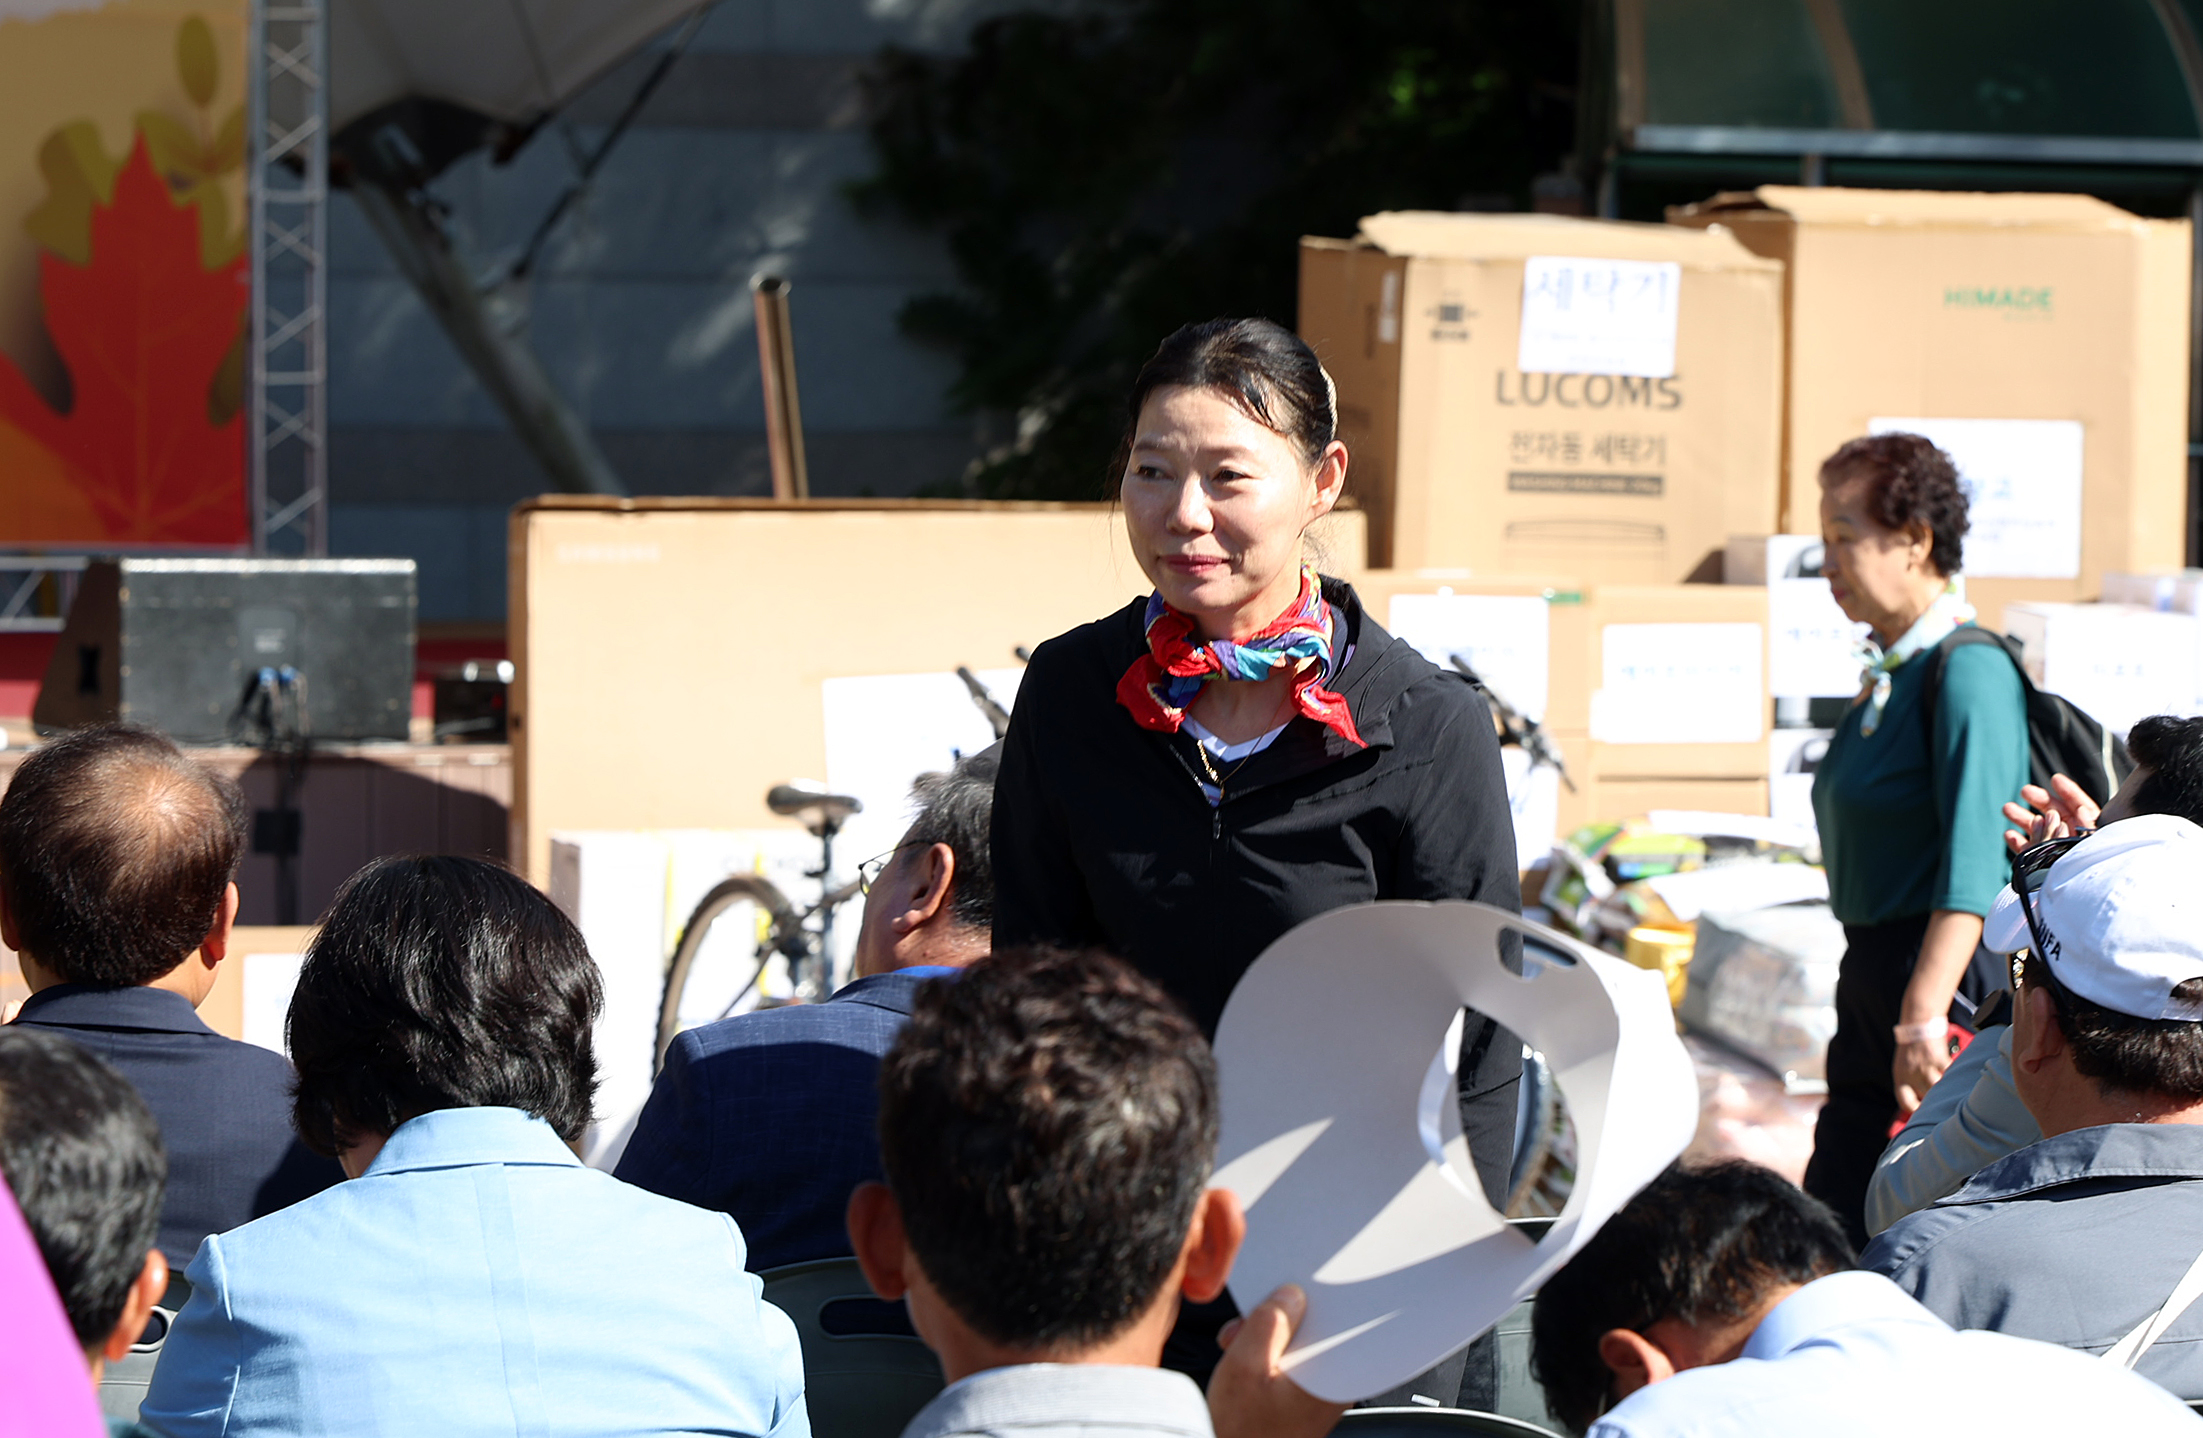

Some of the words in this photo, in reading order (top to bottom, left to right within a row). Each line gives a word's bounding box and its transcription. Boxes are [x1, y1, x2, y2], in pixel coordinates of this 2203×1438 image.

[1526, 266, 1668, 313] 세탁기
[1944, 287, 2054, 311] HIMADE
[1496, 370, 1683, 410] LUCOMS
[1510, 431, 1582, 463] 전자동
[1592, 433, 1666, 466] 세탁기
